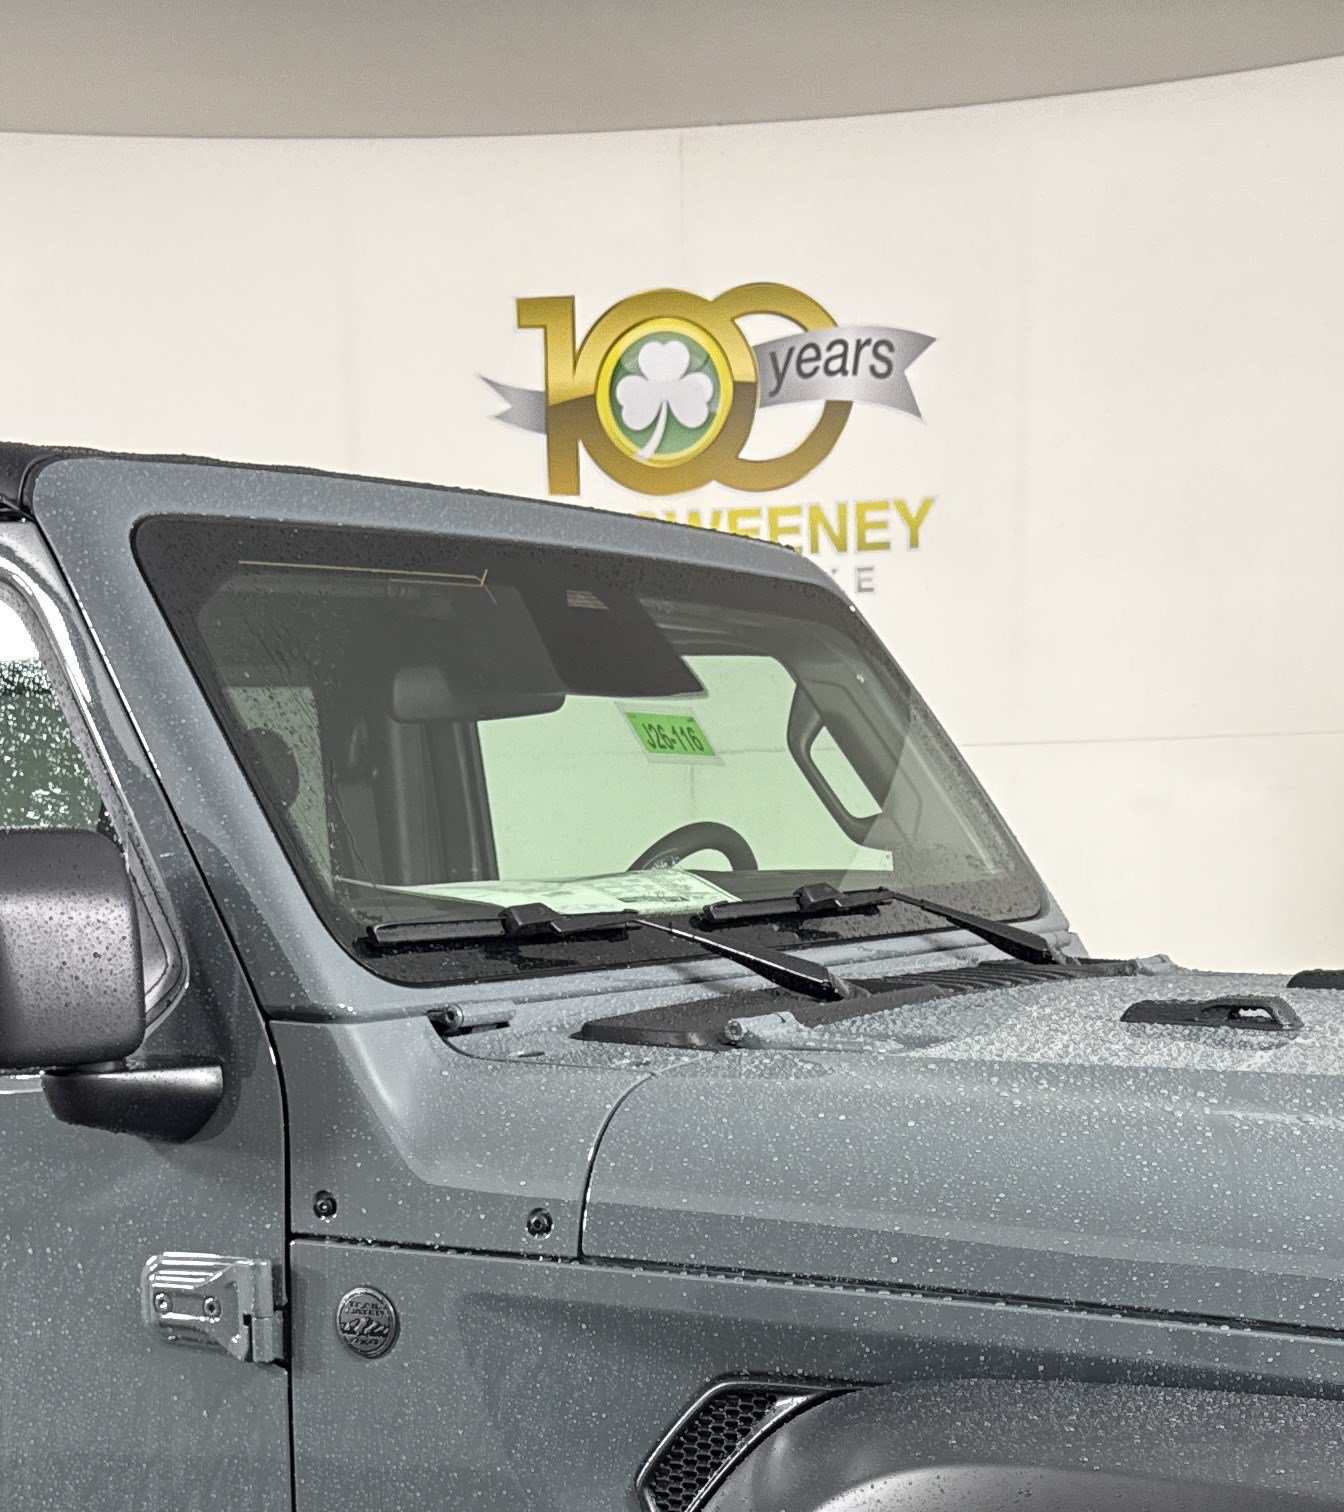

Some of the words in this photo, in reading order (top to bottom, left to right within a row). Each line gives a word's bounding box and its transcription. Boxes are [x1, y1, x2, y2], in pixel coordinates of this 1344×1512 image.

[516, 282, 854, 496] 100
[768, 337, 896, 398] years
[638, 497, 936, 555] EENEY
[642, 723, 705, 752] J26-116
